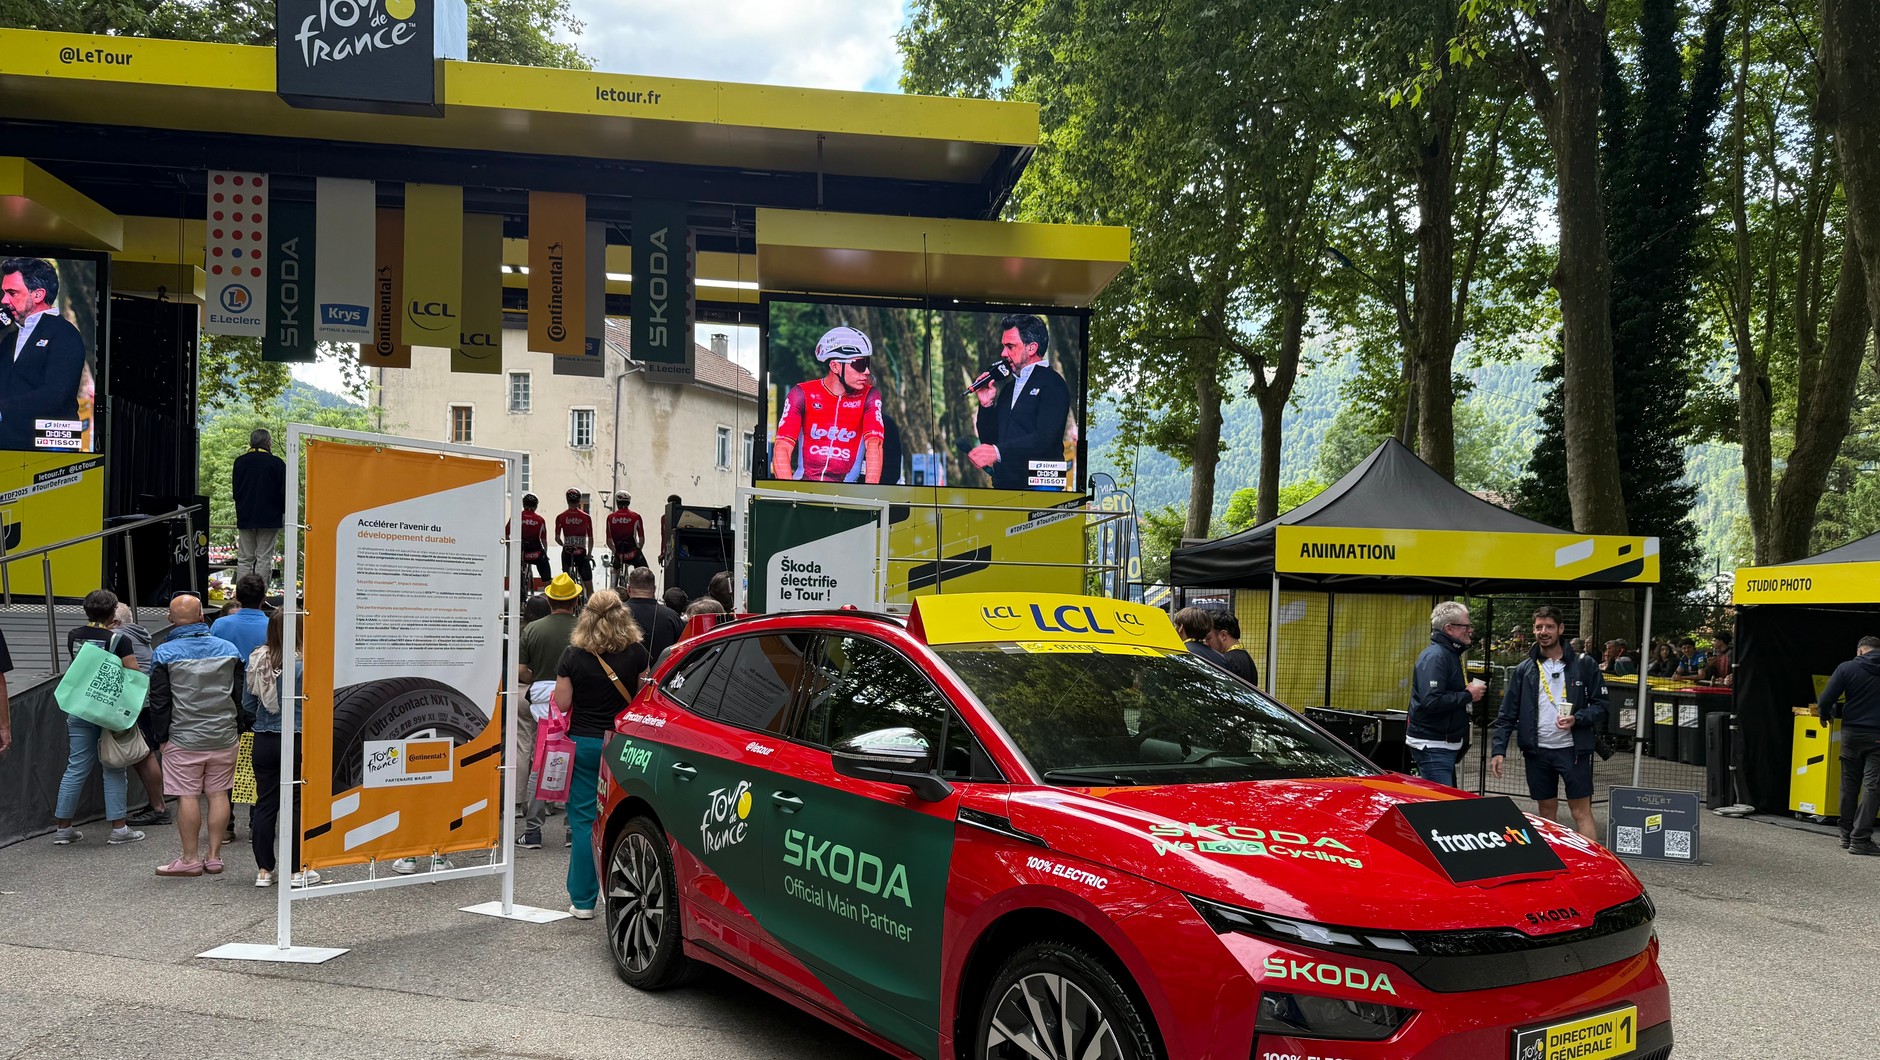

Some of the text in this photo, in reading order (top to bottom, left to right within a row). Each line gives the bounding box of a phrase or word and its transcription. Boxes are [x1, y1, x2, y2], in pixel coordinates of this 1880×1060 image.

[59, 47, 133, 66] @LeTour
[596, 86, 661, 105] letour.fr
[547, 255, 567, 343] Continental
[328, 307, 361, 323] Krys
[376, 277, 395, 357] Continental
[413, 301, 456, 318] LCL
[210, 314, 261, 326] E.Leclerc
[649, 364, 691, 375] E.Leclerc
[809, 445, 851, 459] caps
[38, 460, 97, 482] letour.fr @LeTour
[31, 474, 79, 493] #TourDeFrance
[357, 518, 399, 530] Accélérer
[430, 524, 442, 533] du
[1009, 521, 1034, 534] #TDF2025
[357, 530, 456, 545] développement durable
[1300, 542, 1396, 560] ANIMATION
[781, 556, 821, 574] Škoda
[781, 574, 838, 588] électrifie
[1747, 578, 1812, 592] STUDIO PHOTO
[780, 587, 792, 600] le
[794, 588, 824, 601] Tour
[983, 603, 1144, 634] LCL LCL LCL
[369, 694, 449, 736] UltraContact NXT
[409, 753, 442, 762] Continental
[619, 740, 653, 773] Enyaq
[745, 741, 774, 756] @letour
[1636, 796, 1672, 804] TOULET
[1152, 840, 1195, 856] We
[1269, 845, 1363, 869] Cycling
[1026, 856, 1108, 890] 100% ELECTRIC
[784, 875, 913, 943] Official Main Partner
[1550, 1015, 1631, 1048] DIRECTION 1
[1551, 1037, 1612, 1060] GÉNÉRALE
